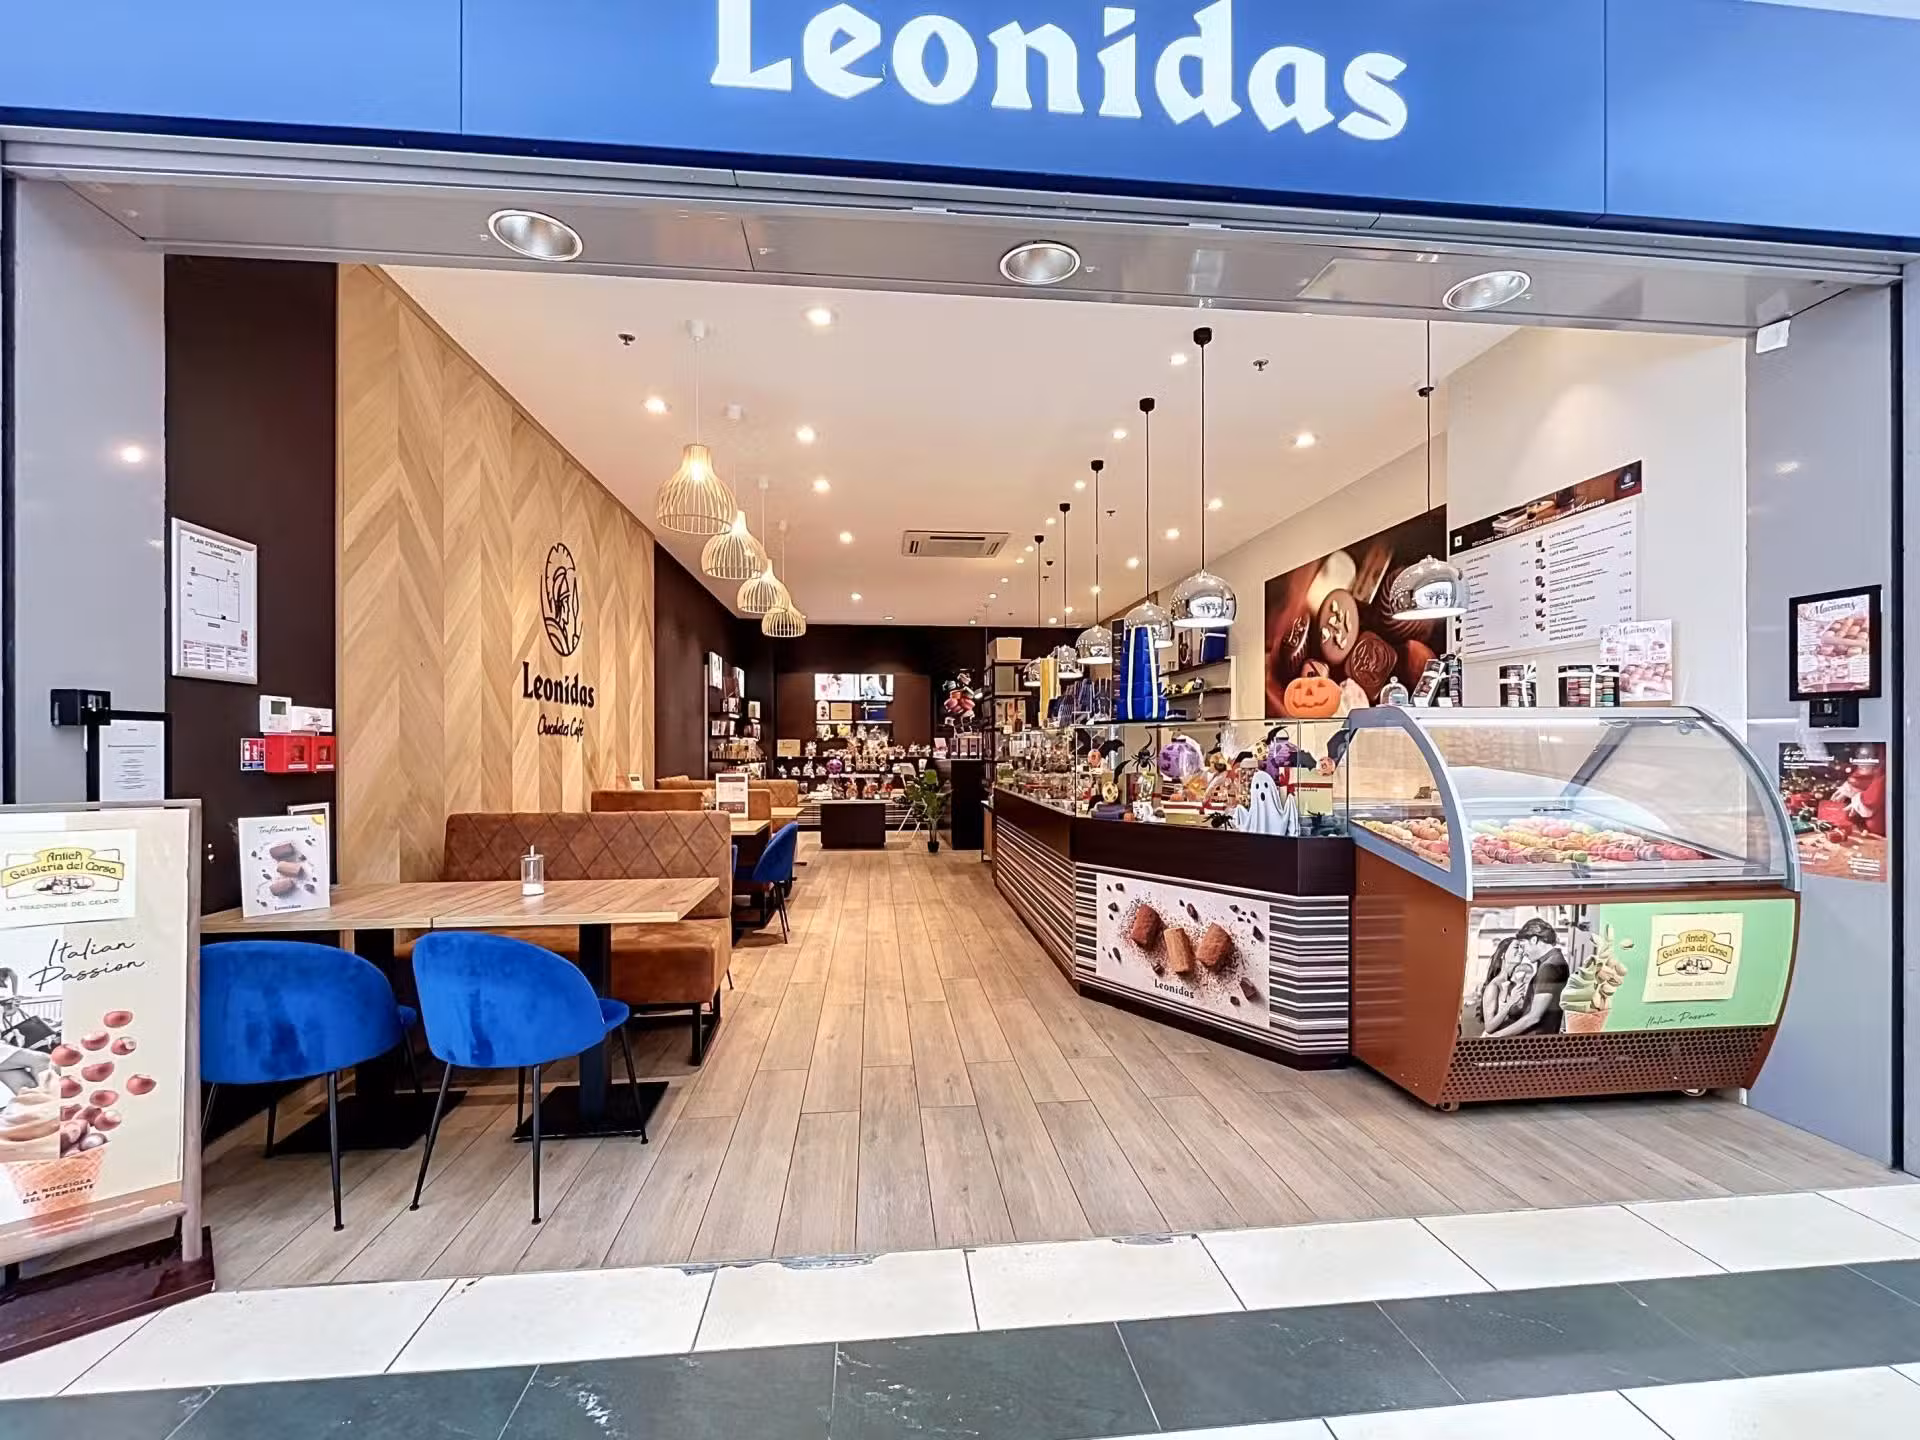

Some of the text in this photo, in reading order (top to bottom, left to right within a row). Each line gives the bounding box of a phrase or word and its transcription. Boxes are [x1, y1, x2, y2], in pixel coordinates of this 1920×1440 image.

[710, 0, 1408, 141] Leonidas
[522, 661, 595, 708] Leonidas
[10, 861, 117, 880] Gelateria del Corso
[49, 937, 135, 966] Italian
[28, 960, 145, 992] Passion
[1154, 978, 1195, 999] Leonidas
[22, 1183, 95, 1204] DEL PIEMONTE
